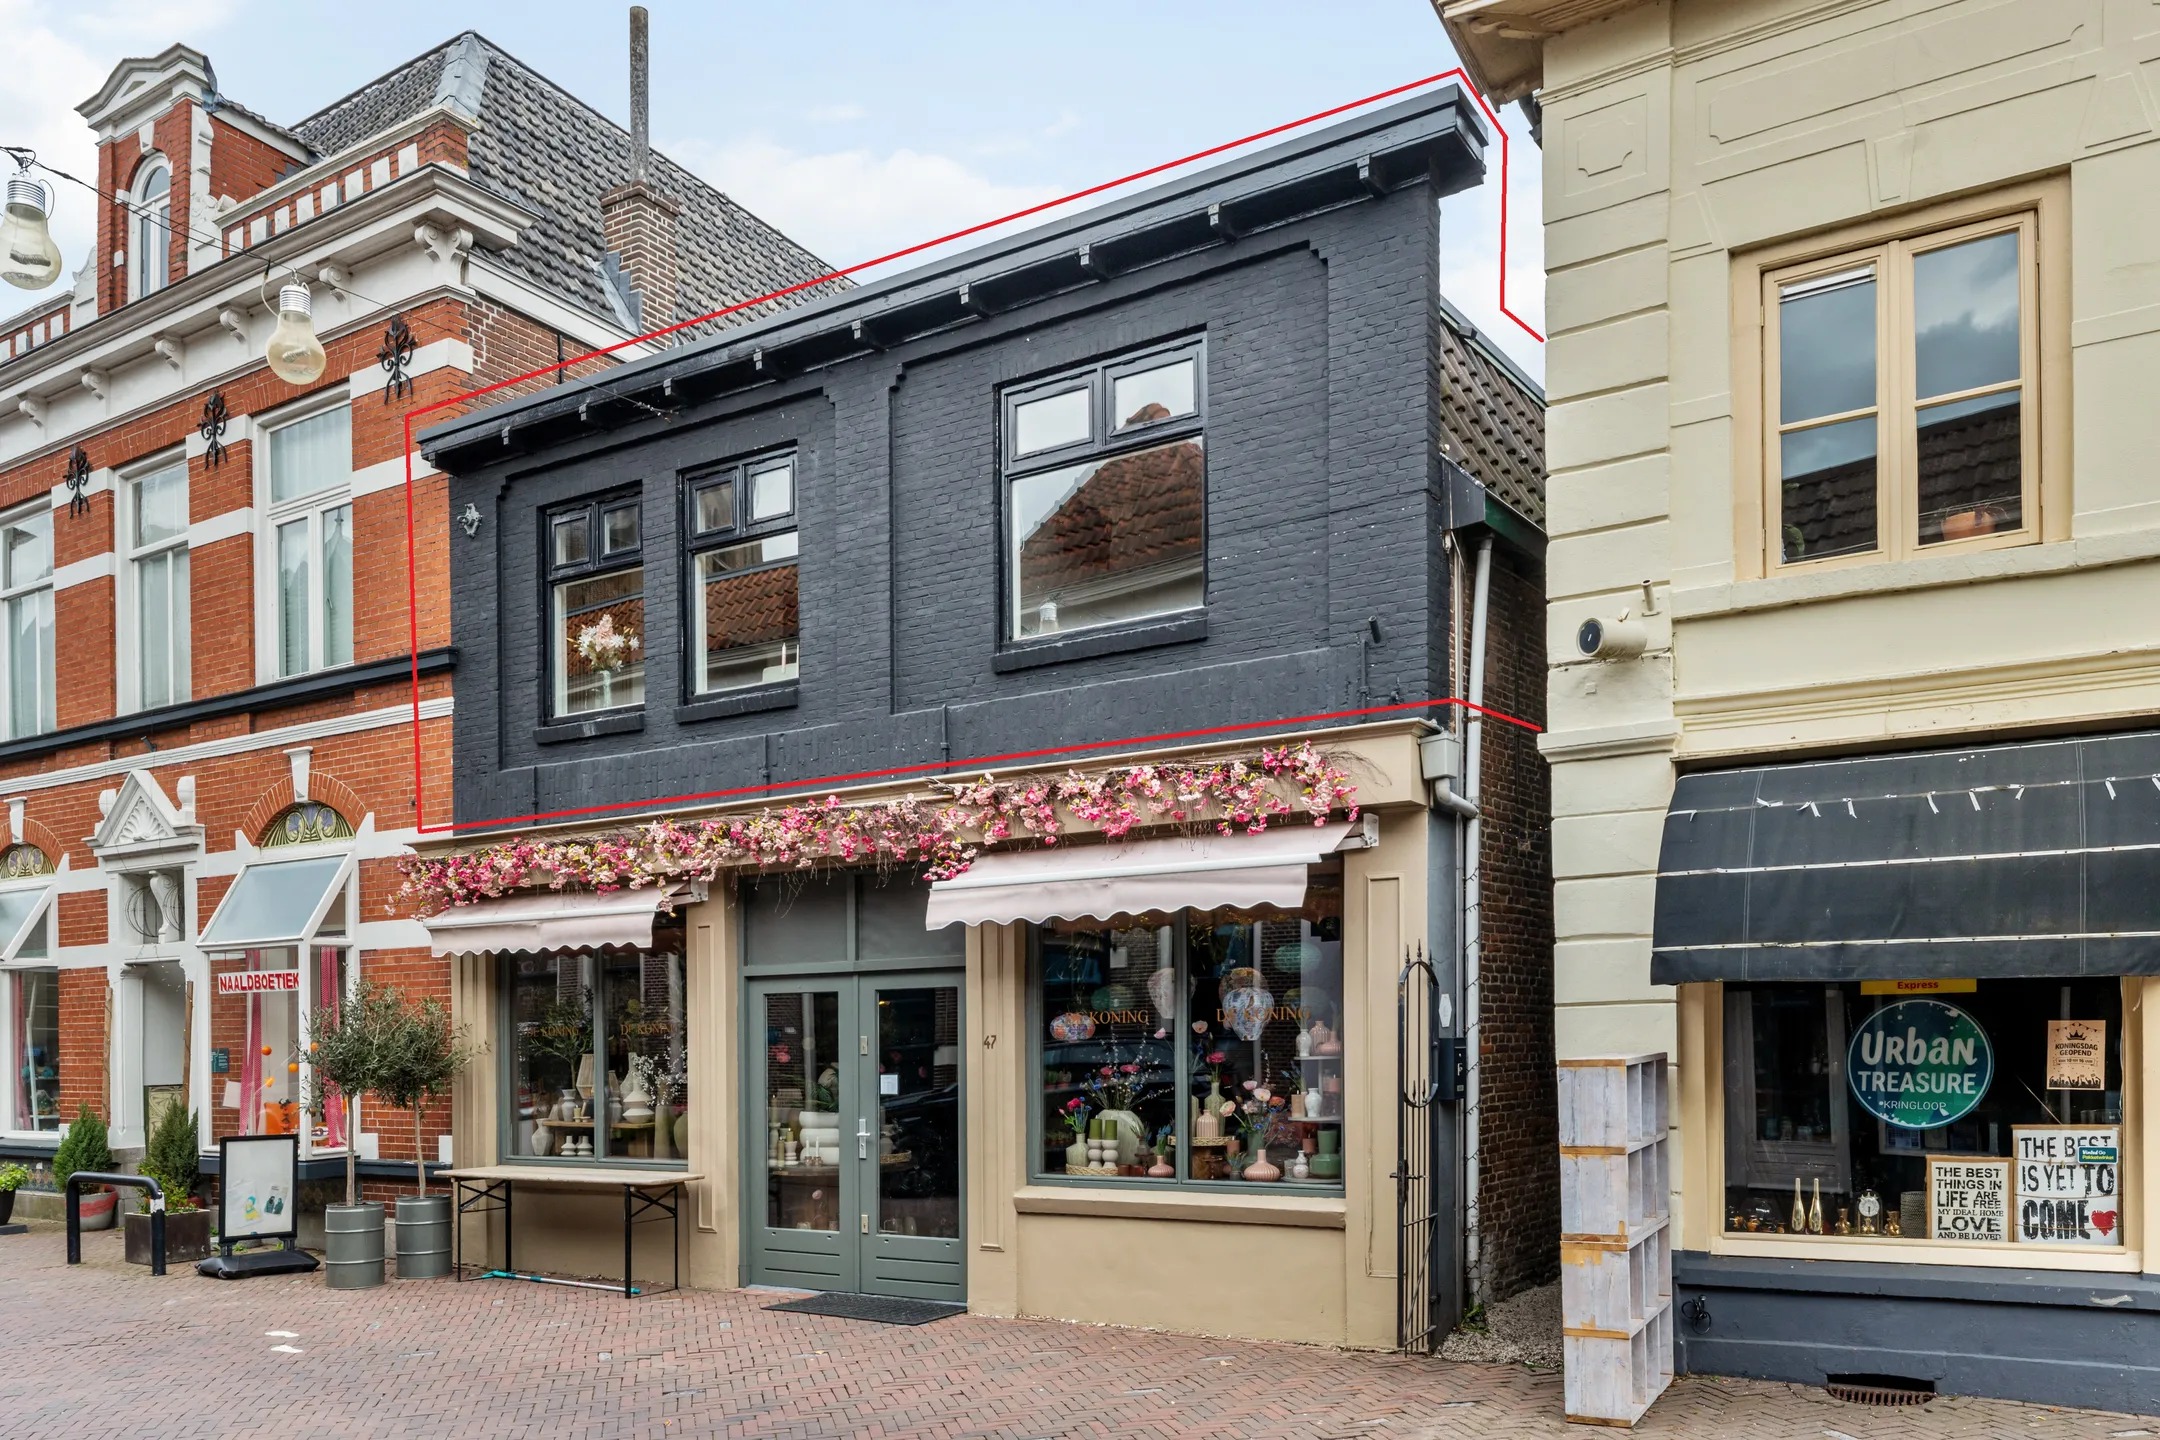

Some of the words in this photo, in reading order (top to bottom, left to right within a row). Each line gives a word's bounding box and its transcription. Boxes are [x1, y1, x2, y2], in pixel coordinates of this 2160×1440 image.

[219, 972, 299, 992] NAALDBOETIEK
[1897, 981, 1939, 990] Express
[1089, 1009, 1149, 1025] KONING
[1244, 1006, 1312, 1022] KONING
[983, 1035, 997, 1050] 47
[2055, 1043, 2098, 1051] KONINGSDAG
[1858, 1071, 1977, 1095] TREASURE
[1883, 1100, 1947, 1112] KRINGLOOP
[2020, 1137, 2057, 1158] THE
[1935, 1167, 1961, 1177] THE
[1966, 1168, 2001, 1178] BEST
[2022, 1165, 2039, 1191] IS
[2043, 1165, 2076, 1191] YET
[2080, 1164, 2114, 1197] TO
[1936, 1179, 1985, 1190] THINGS
[1989, 1180, 2002, 1190] IN
[1937, 1190, 1968, 1207] LIFE
[1975, 1191, 1998, 1200] ARE
[1973, 1200, 2001, 1209] FREE
[1937, 1215, 2001, 1232] LOVE
[2022, 1199, 2090, 1240] COME
[1937, 1231, 1956, 1239] AND
